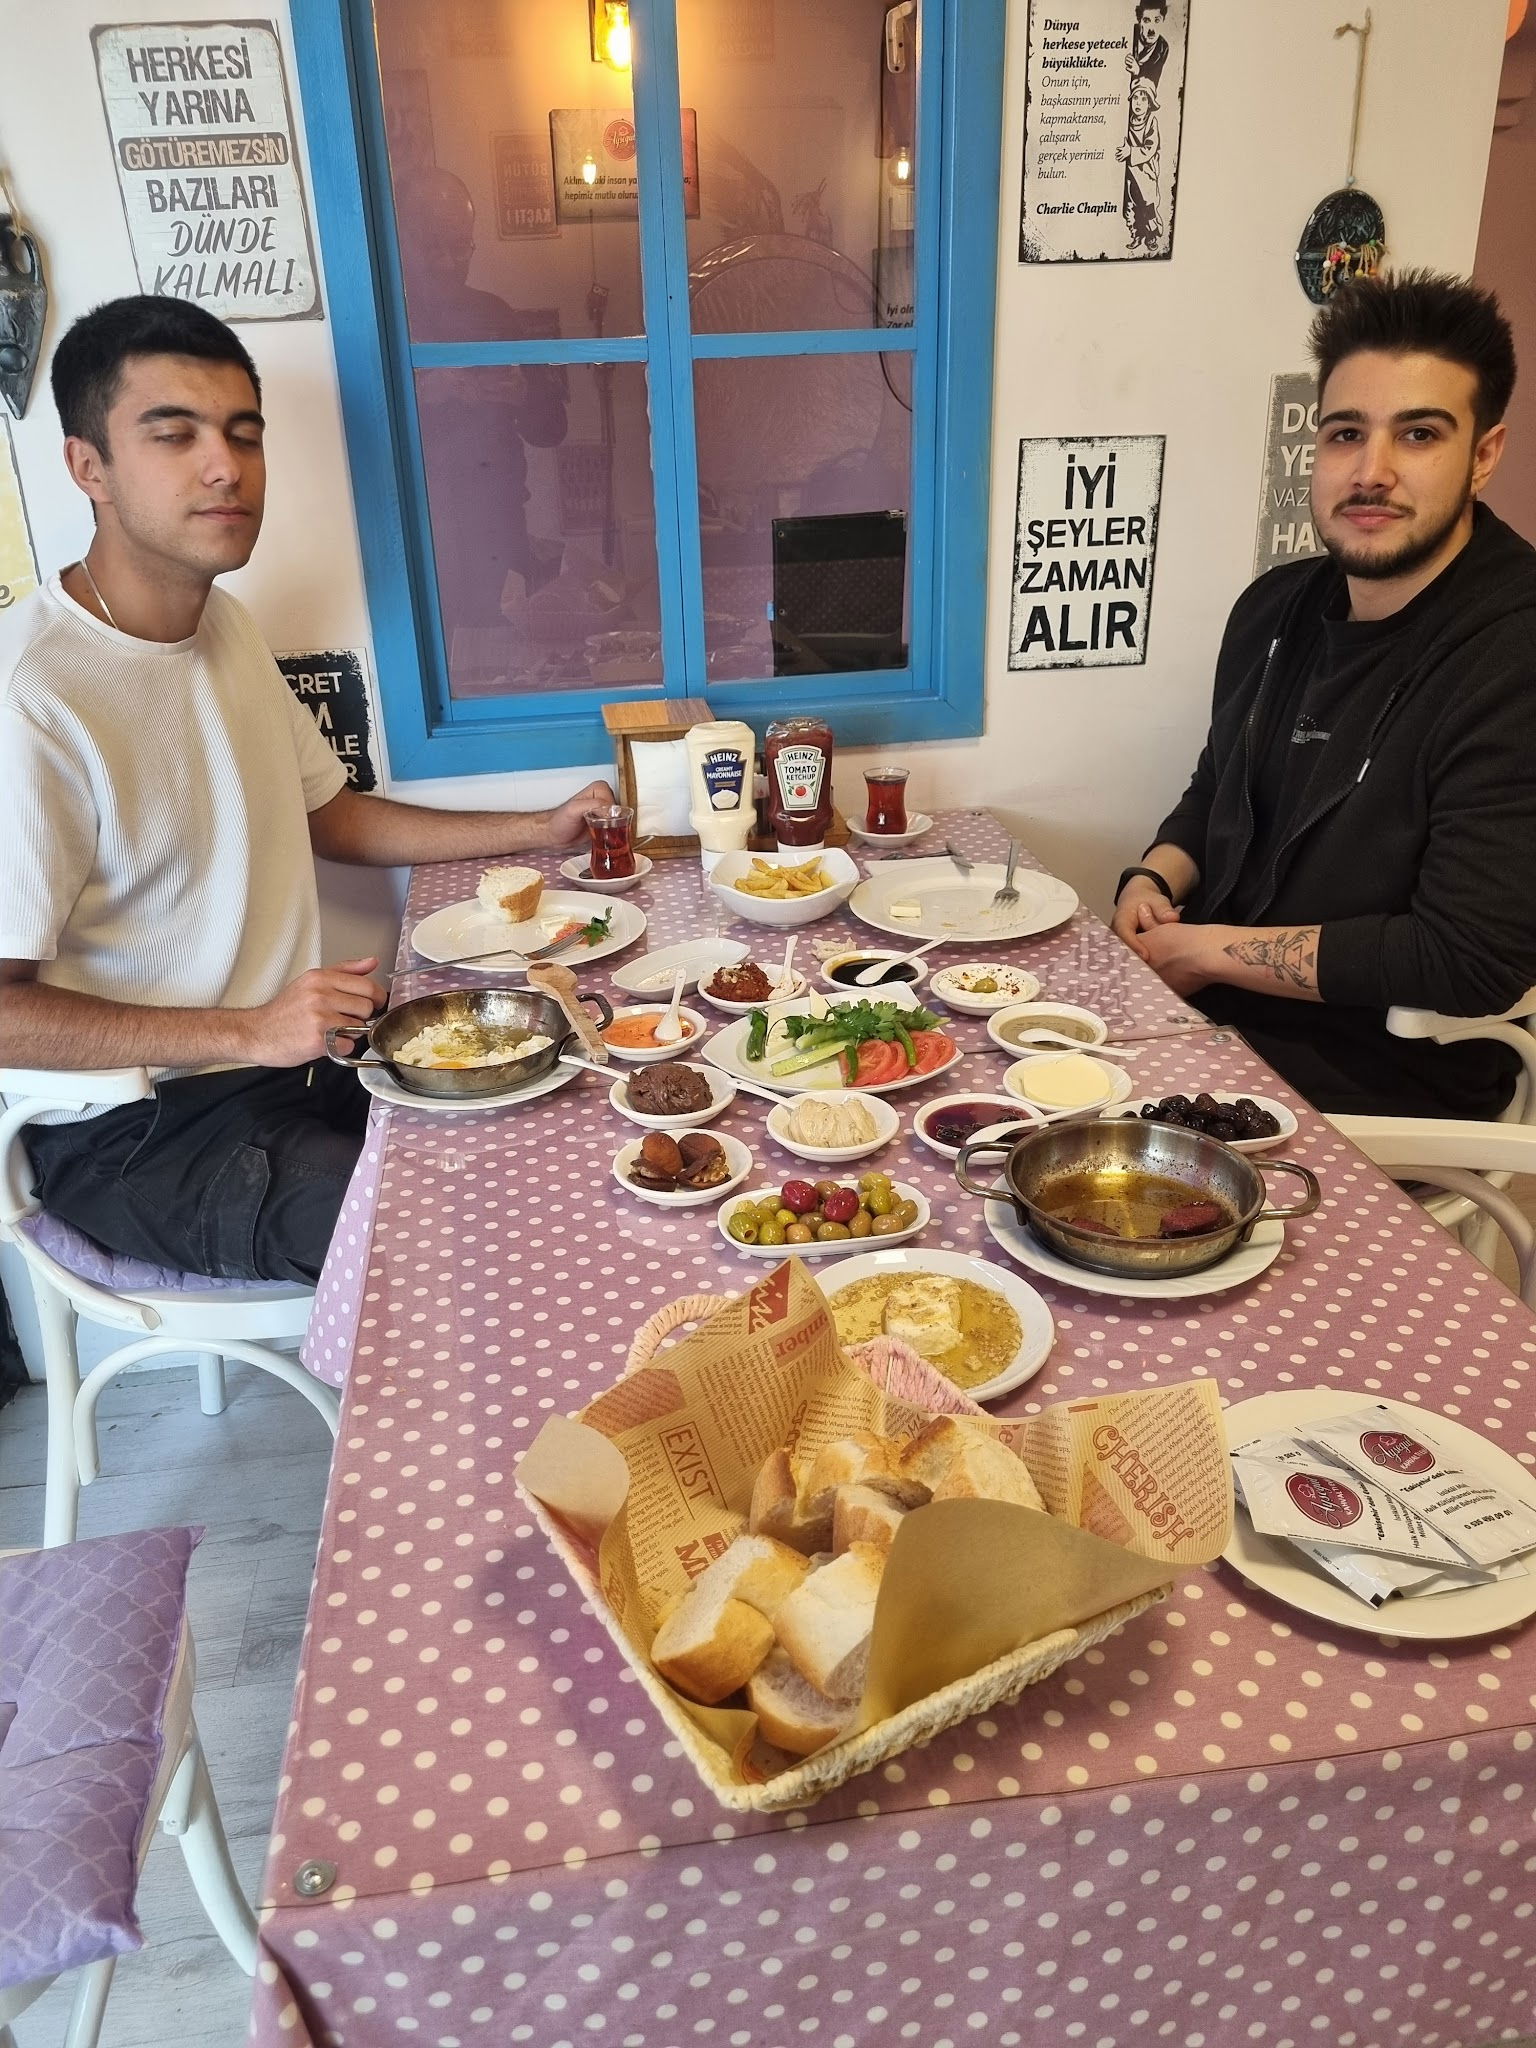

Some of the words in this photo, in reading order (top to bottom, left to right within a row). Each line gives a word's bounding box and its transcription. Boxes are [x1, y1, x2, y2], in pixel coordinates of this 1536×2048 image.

[1044, 18, 1080, 32] Dünya
[1042, 37, 1085, 50] herkese
[1086, 37, 1128, 53] yetecek
[126, 37, 252, 82] HERKESİ
[1042, 55, 1107, 73] büyüklükte.
[1042, 76, 1070, 88] Onun
[1072, 75, 1092, 90] için,
[138, 88, 256, 126] YARINA
[1040, 94, 1092, 108] başkasının
[1092, 94, 1121, 108] yerini
[1040, 114, 1107, 130] kapmaktansa,
[1039, 132, 1081, 146] çalışarak
[124, 134, 285, 169] GÖTÜREMEZSİN
[1038, 150, 1067, 164] gerçek
[1067, 149, 1104, 164] yerinizi
[1038, 168, 1067, 180] bulun.
[146, 174, 279, 213] BAZILARI
[564, 192, 592, 201] hepimiz
[1036, 202, 1074, 216] Charlie
[1077, 202, 1118, 217] Chaplin
[167, 213, 276, 257] DÜNDE
[1065, 452, 1116, 510] İYİ
[1027, 516, 1146, 557] ŞEYLER
[1272, 522, 1327, 555] HA
[1020, 558, 1147, 594] ZAMAN
[1019, 601, 1138, 653] ALIR
[327, 734, 360, 756] LE
[710, 752, 738, 764] HEINZ
[788, 752, 814, 761] HEINZ
[706, 770, 742, 779] MAYONNAISE
[784, 765, 817, 774] TOMATO
[666, 1428, 714, 1500] EXIST
[1092, 1424, 1194, 1552] CHERISH
